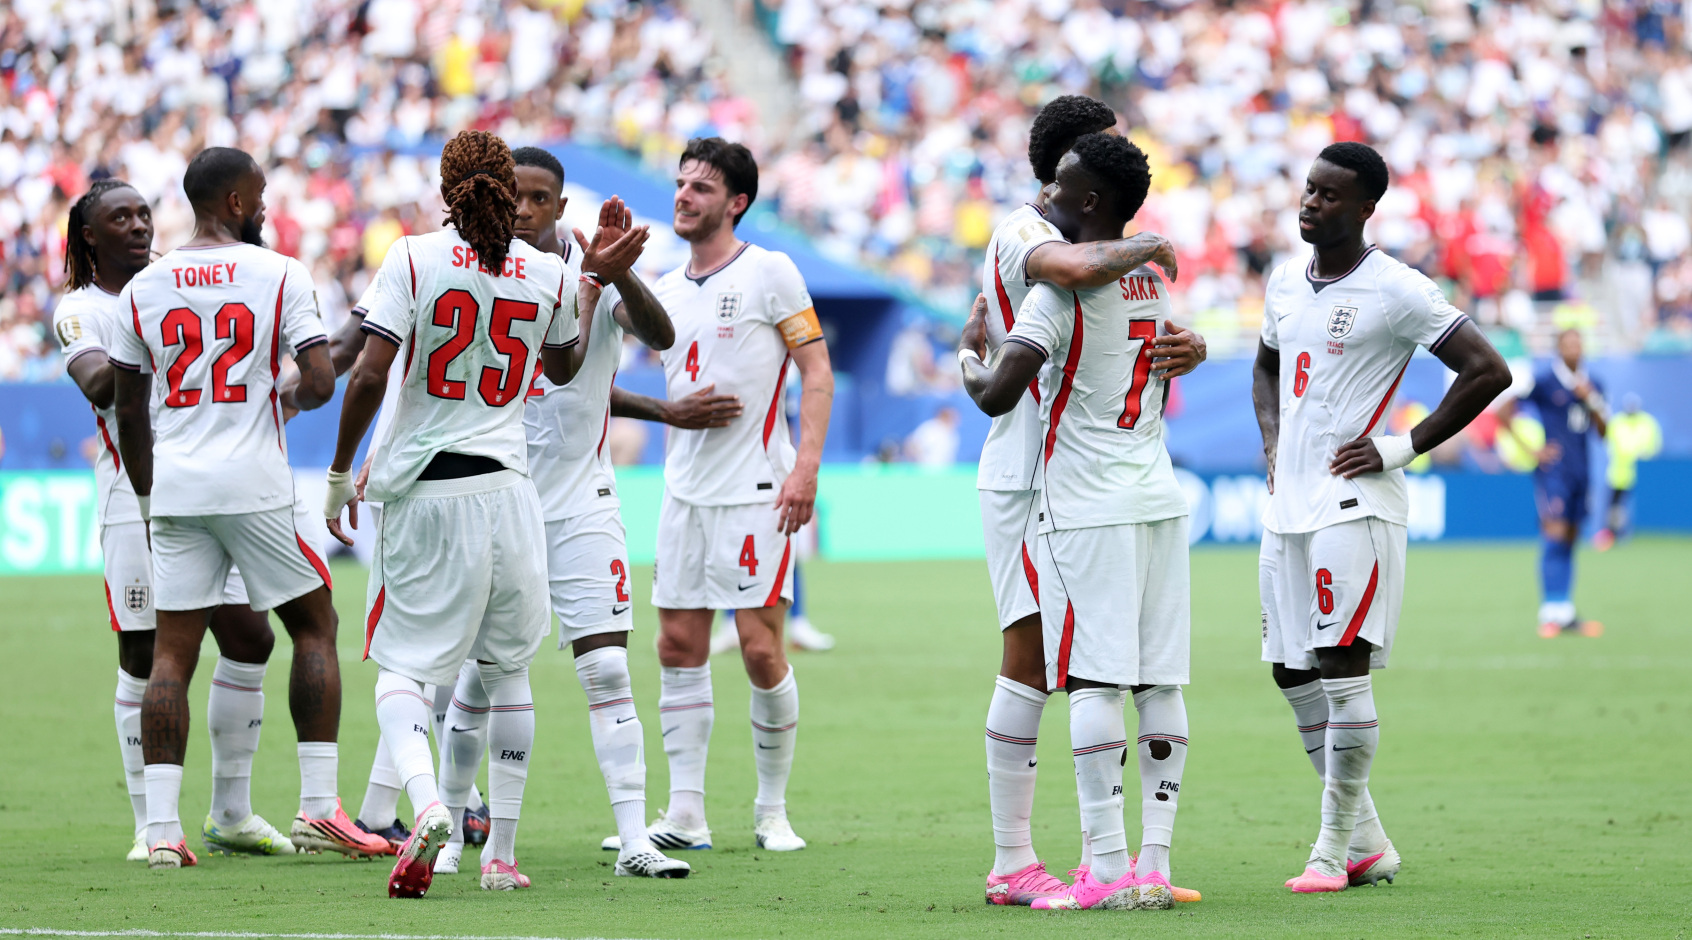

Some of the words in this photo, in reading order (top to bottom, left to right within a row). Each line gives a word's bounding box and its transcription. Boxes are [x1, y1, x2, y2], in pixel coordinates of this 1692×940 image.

[172, 253, 237, 289] TONEY
[452, 245, 526, 280] SPCE
[1119, 276, 1159, 301] SAKA
[160, 302, 255, 408] 22
[427, 288, 539, 407] 25
[685, 340, 700, 382] 4
[1116, 319, 1157, 430] 7
[1293, 351, 1311, 398] 6
[739, 534, 759, 577] 4
[610, 559, 629, 603] 2
[1316, 567, 1334, 615] 6
[127, 736, 142, 746] EN
[500, 749, 526, 761] ENG
[1112, 785, 1122, 795] EN
[1159, 780, 1179, 792] ENG
